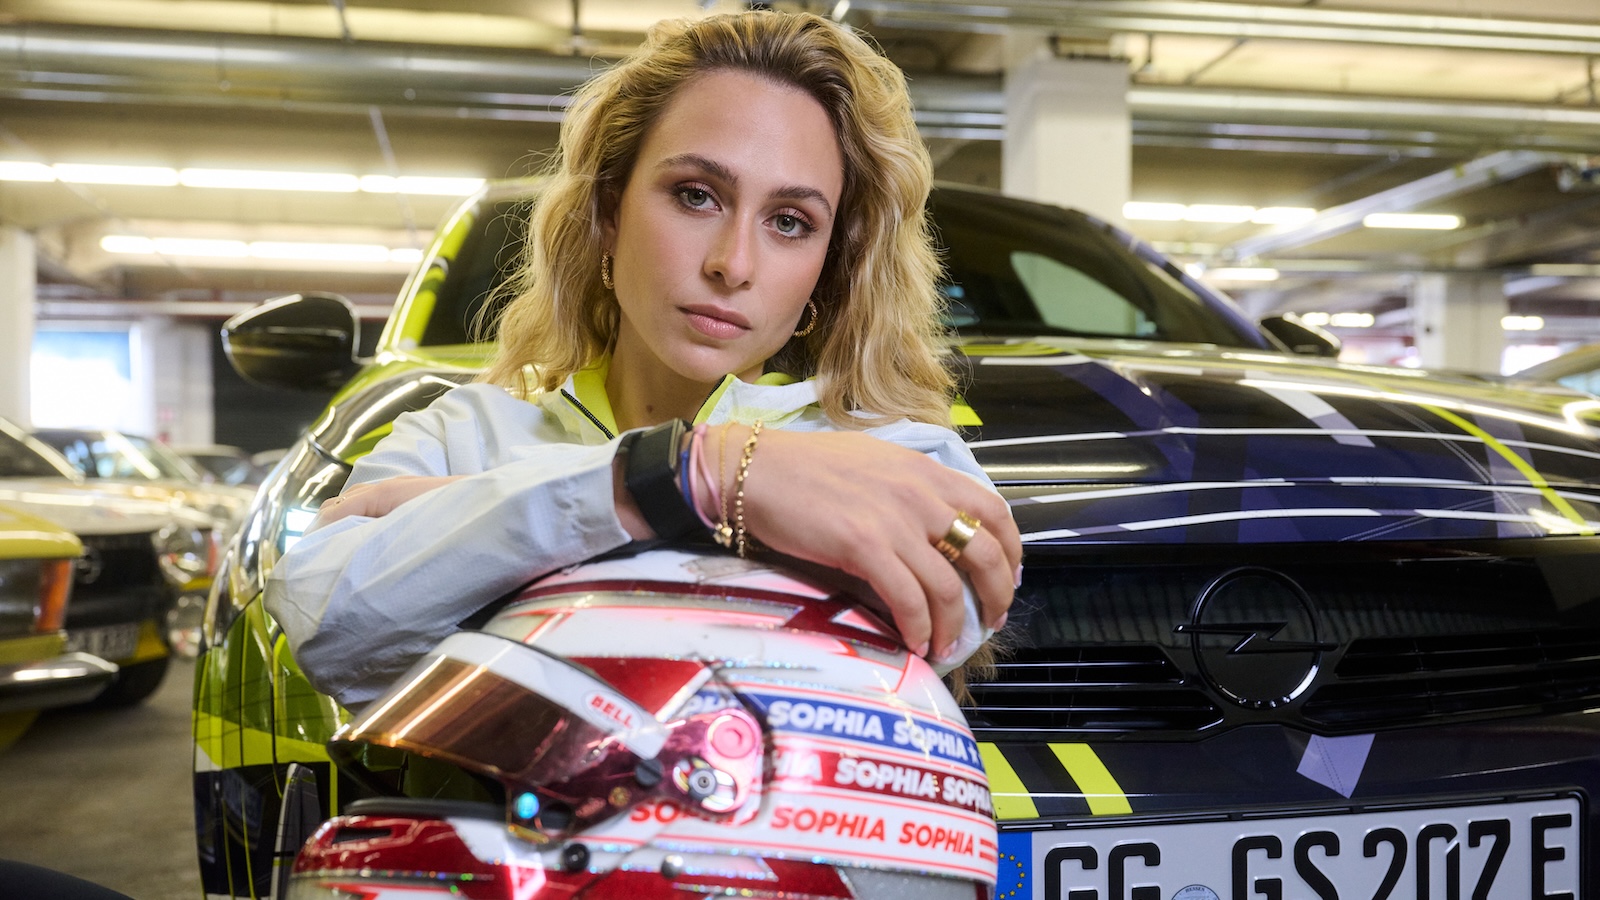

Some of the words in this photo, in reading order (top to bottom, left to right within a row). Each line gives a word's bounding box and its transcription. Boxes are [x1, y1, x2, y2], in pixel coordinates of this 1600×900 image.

[591, 695, 633, 729] BELL
[767, 700, 885, 740] SOPHIA
[893, 720, 968, 760] SOPHIA
[834, 757, 936, 799] SOPHIA
[771, 807, 885, 841] SOPHIA
[899, 821, 974, 857] SOPHIA
[1044, 842, 1160, 900] GG
[1232, 832, 1340, 900] GS
